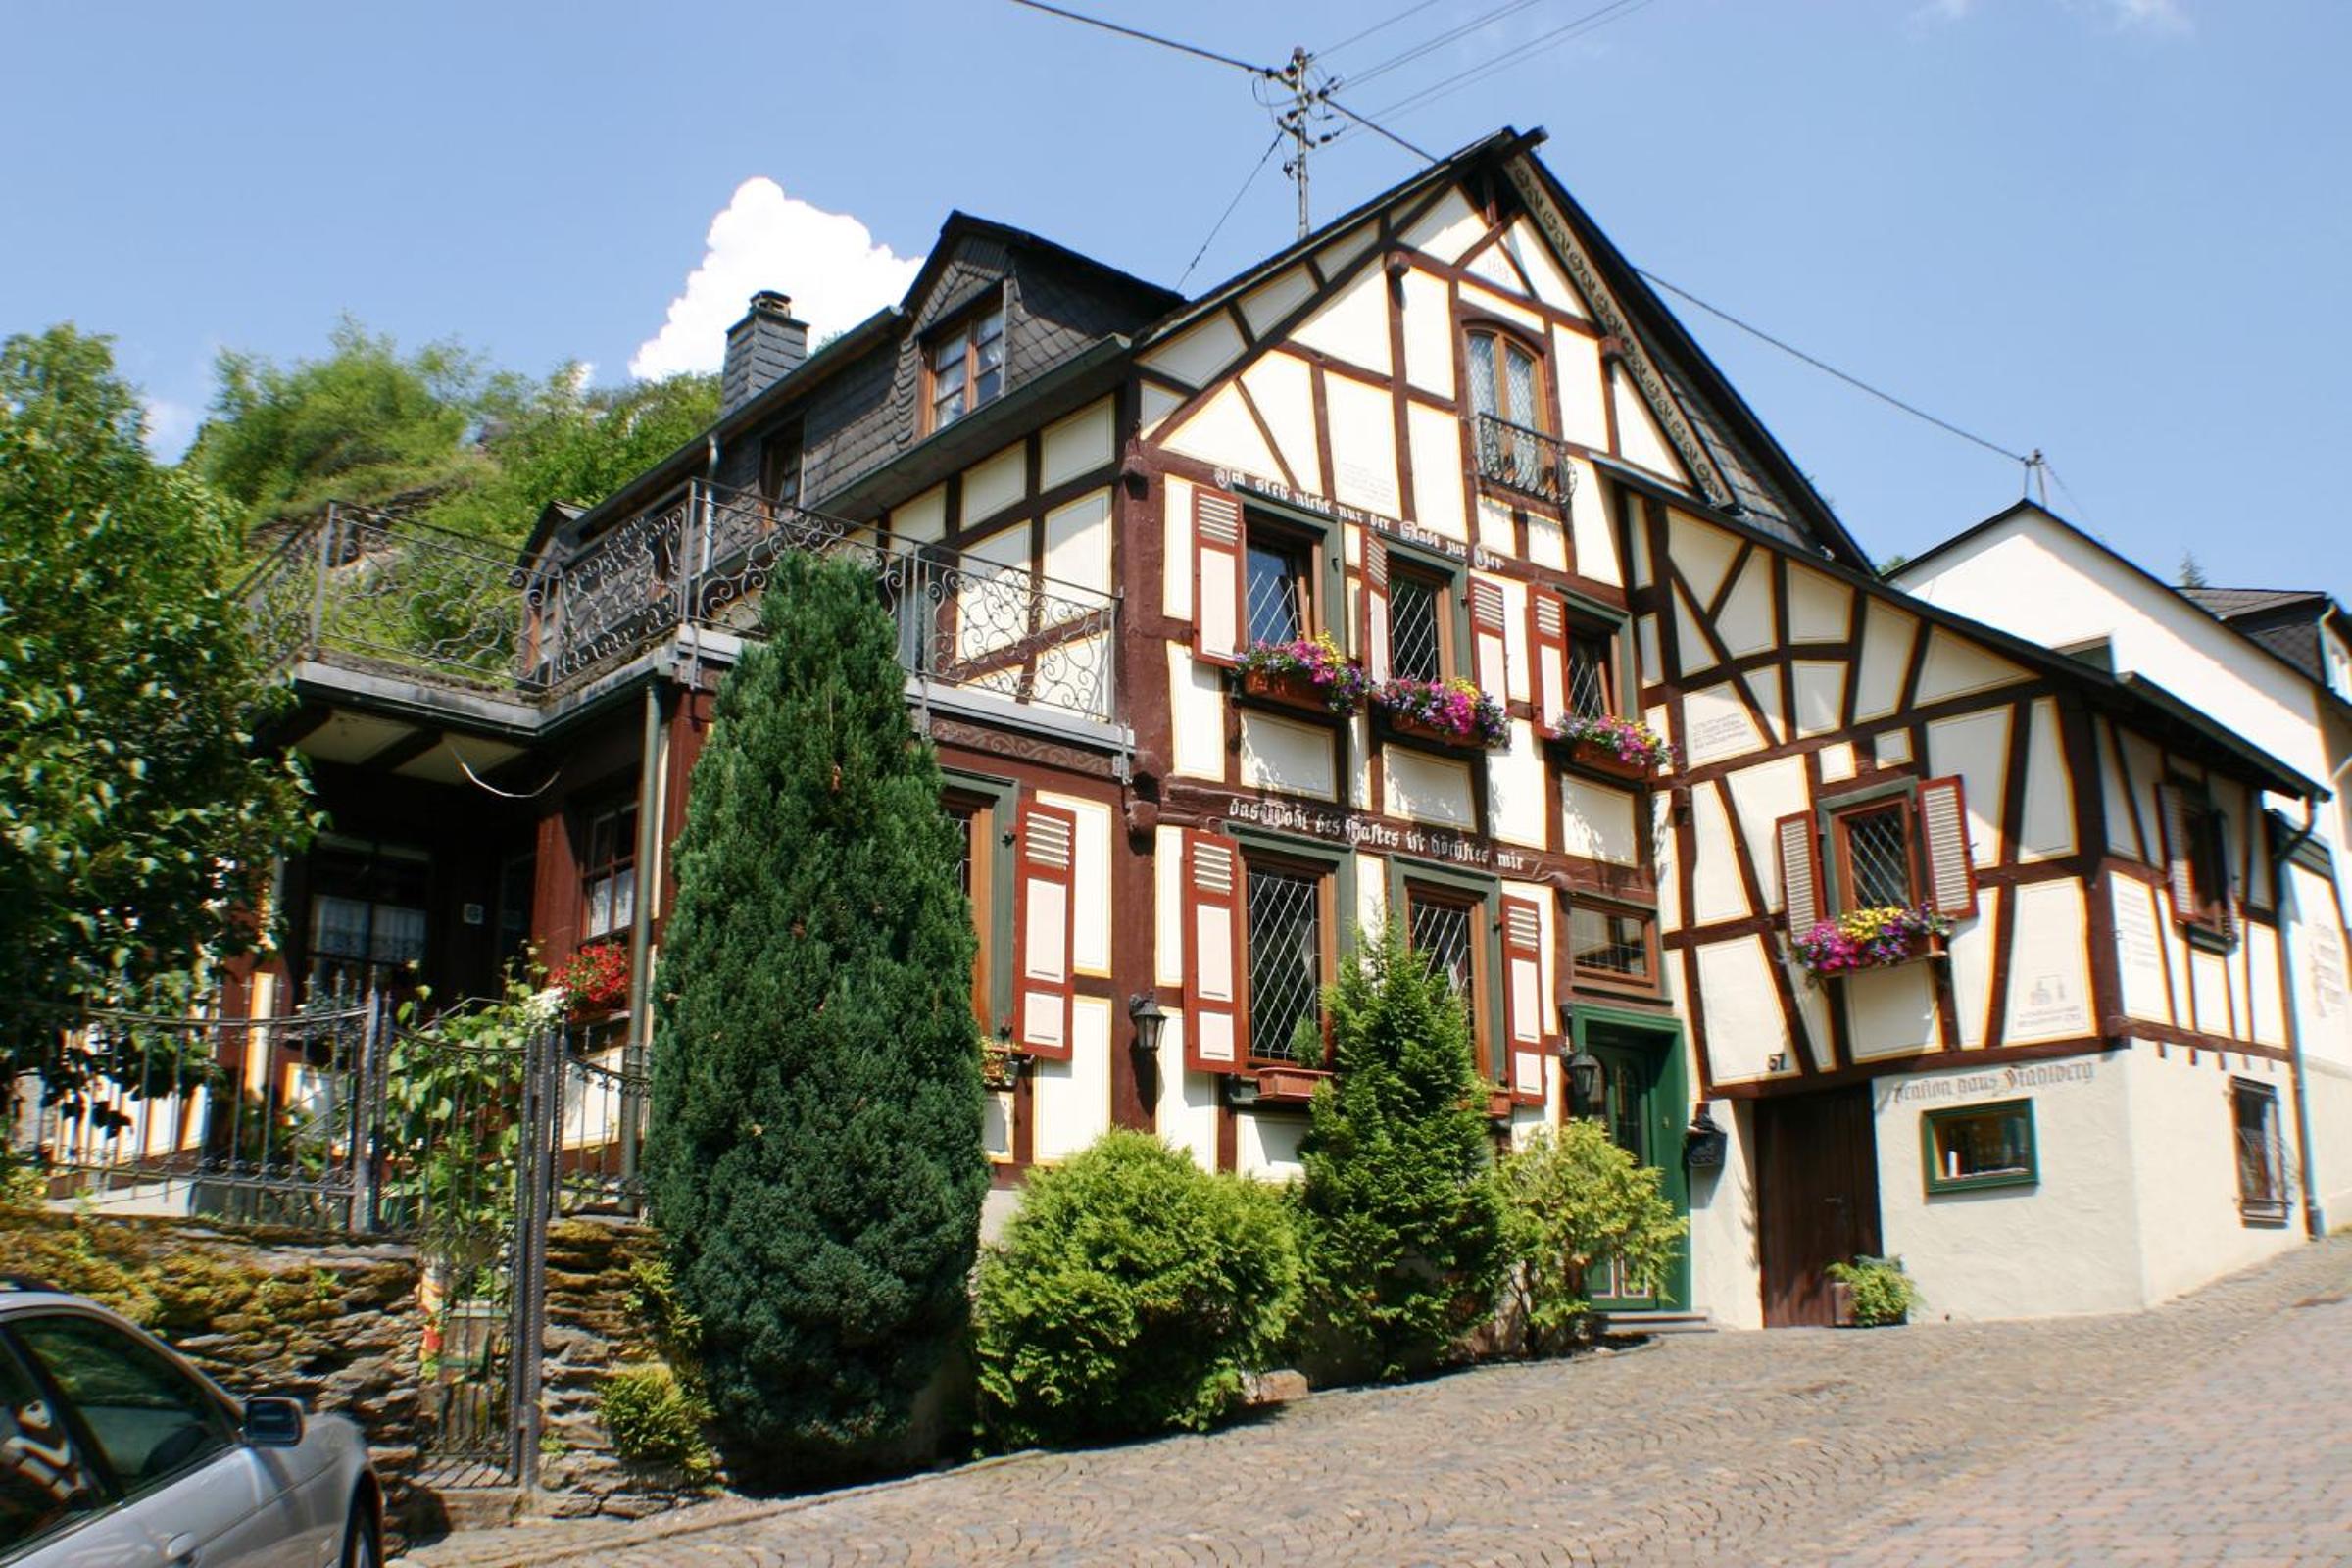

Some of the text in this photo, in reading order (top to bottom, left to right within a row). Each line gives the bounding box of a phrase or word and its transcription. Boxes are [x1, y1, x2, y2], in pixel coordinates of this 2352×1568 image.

[1294, 491, 1333, 514] nicht
[1337, 504, 1364, 522] nur
[1369, 513, 1391, 530] der
[1315, 813, 1342, 836] des
[1496, 851, 1524, 870] mir
